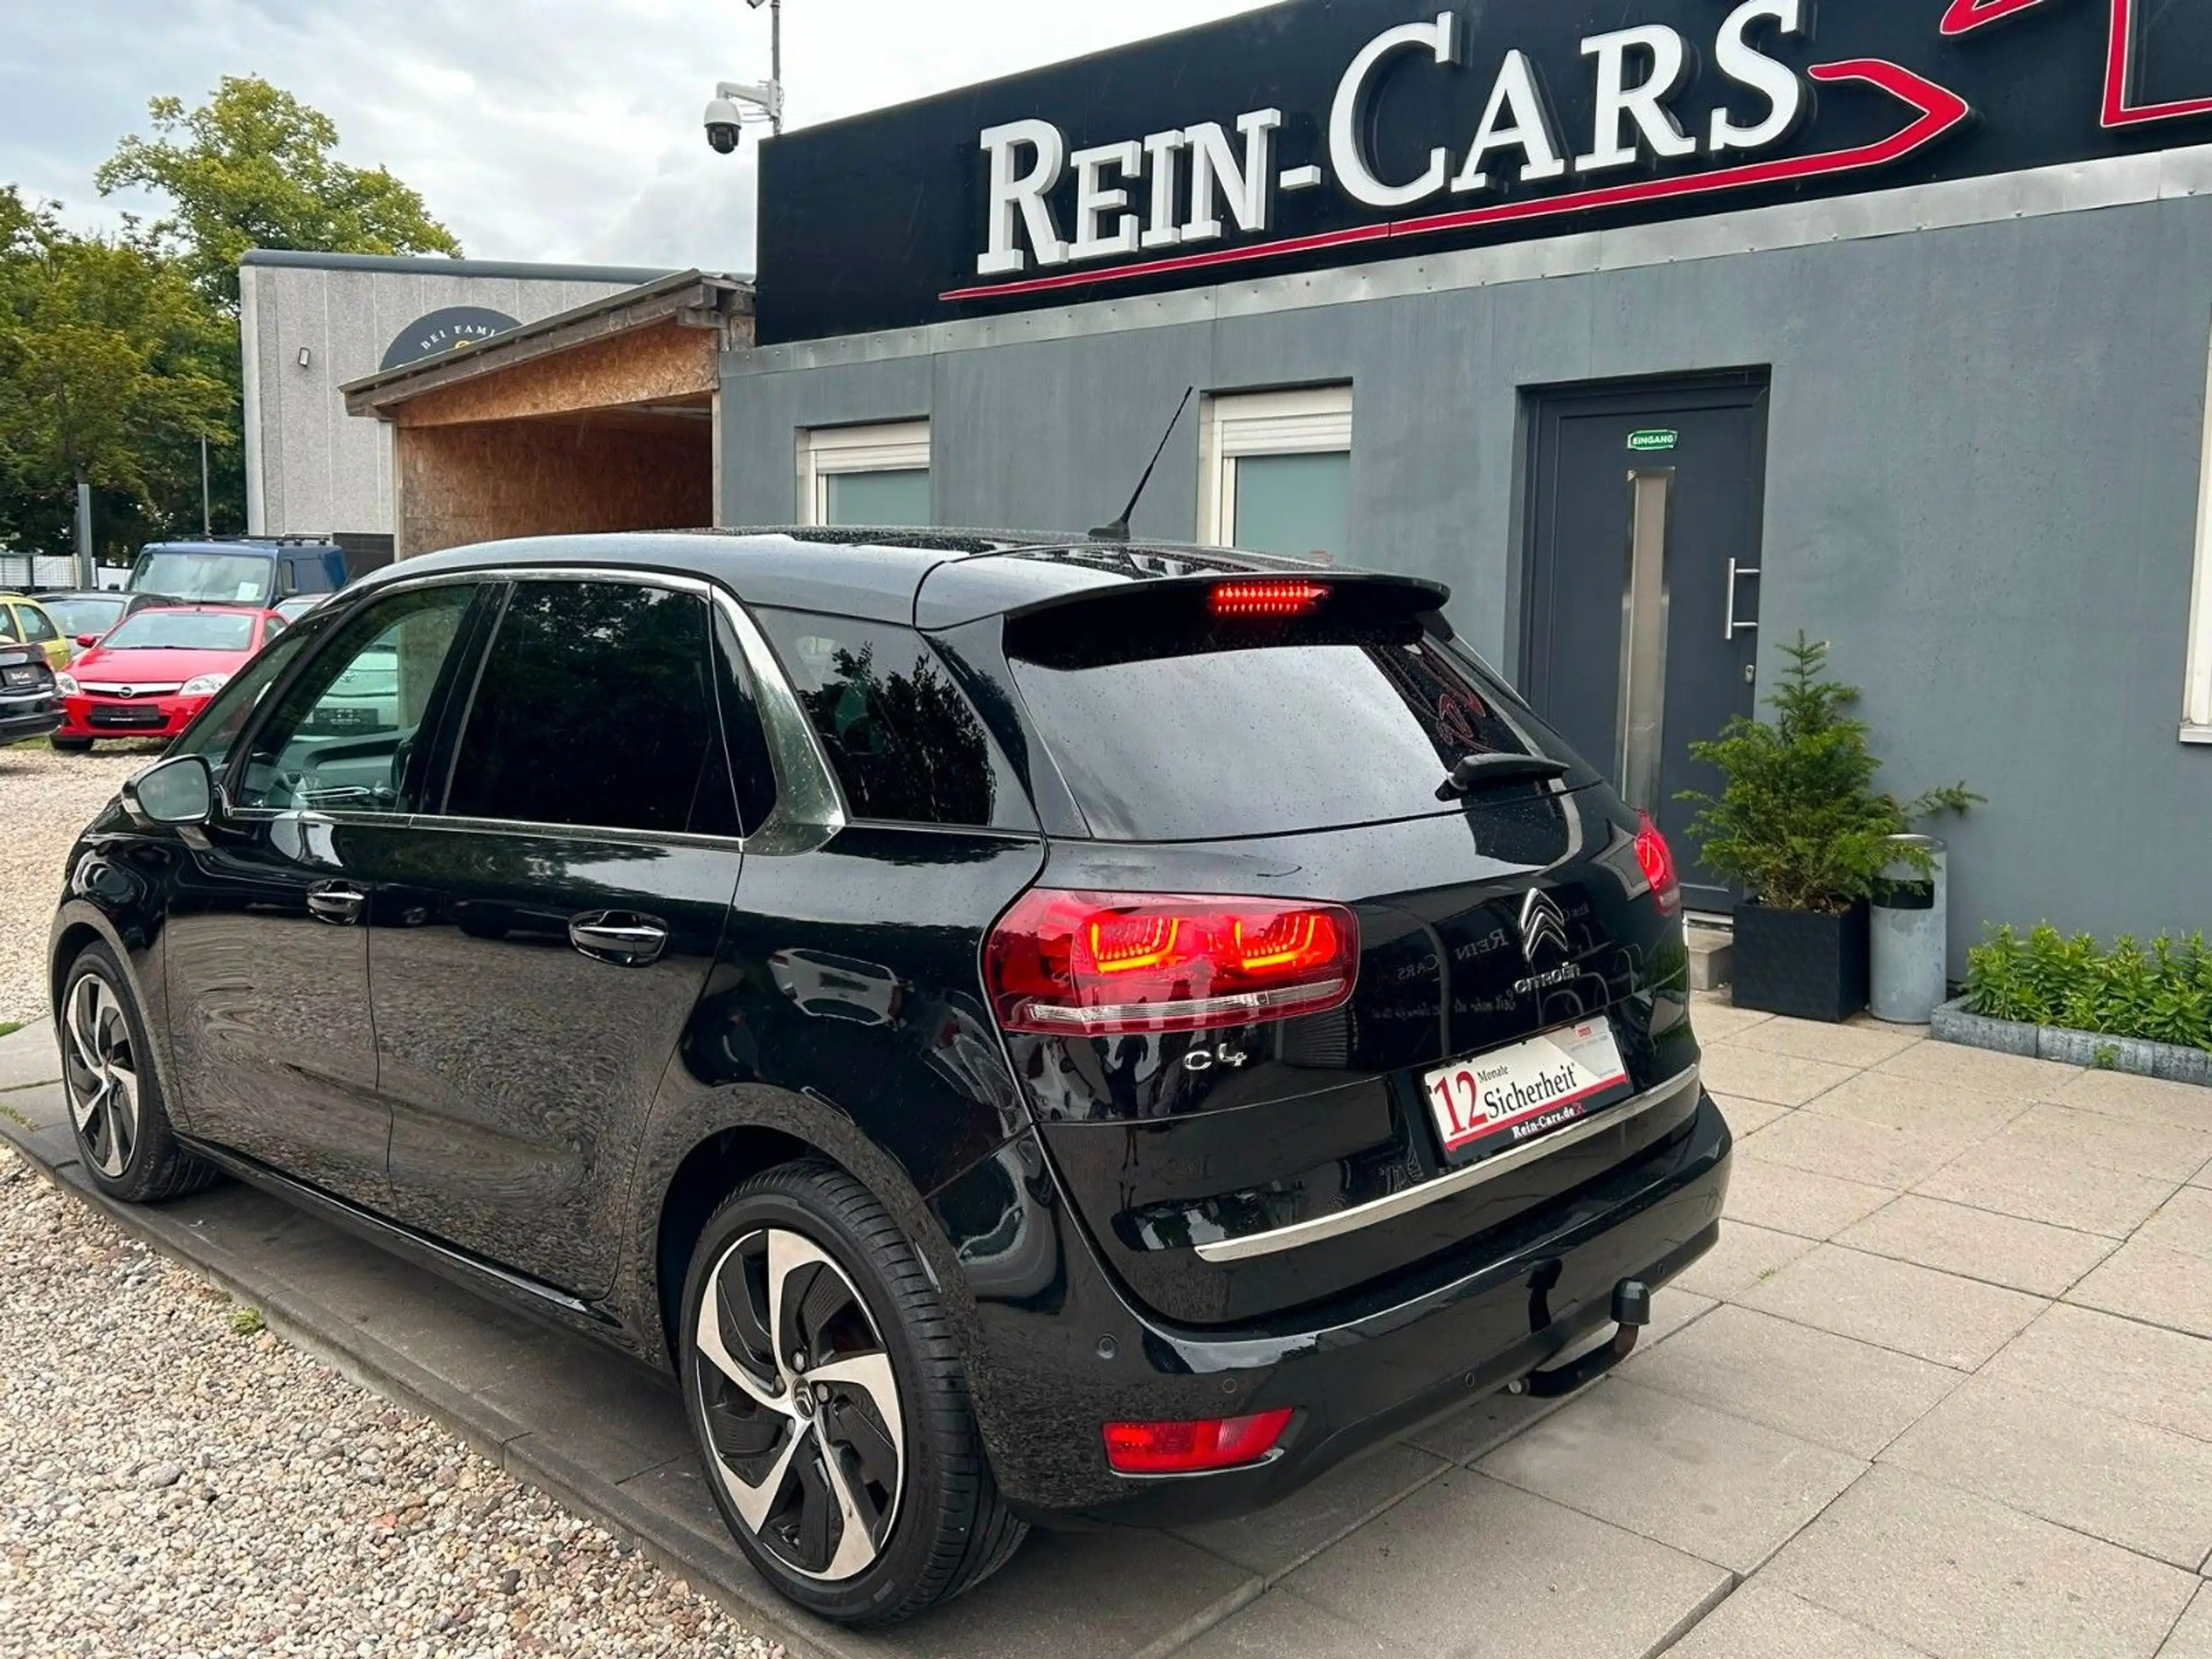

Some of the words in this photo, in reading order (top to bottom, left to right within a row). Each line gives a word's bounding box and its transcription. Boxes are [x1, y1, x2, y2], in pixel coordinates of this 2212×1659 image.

[421, 330, 446, 350] BEI
[1633, 434, 1673, 445] EINGANG
[1184, 1043, 1248, 1070] C4
[1477, 1065, 1509, 1084] Monate
[1433, 1070, 1488, 1136] 12
[1484, 1064, 1577, 1119] Sicherheit
[1512, 1107, 1575, 1139] Rein-Cars.de
